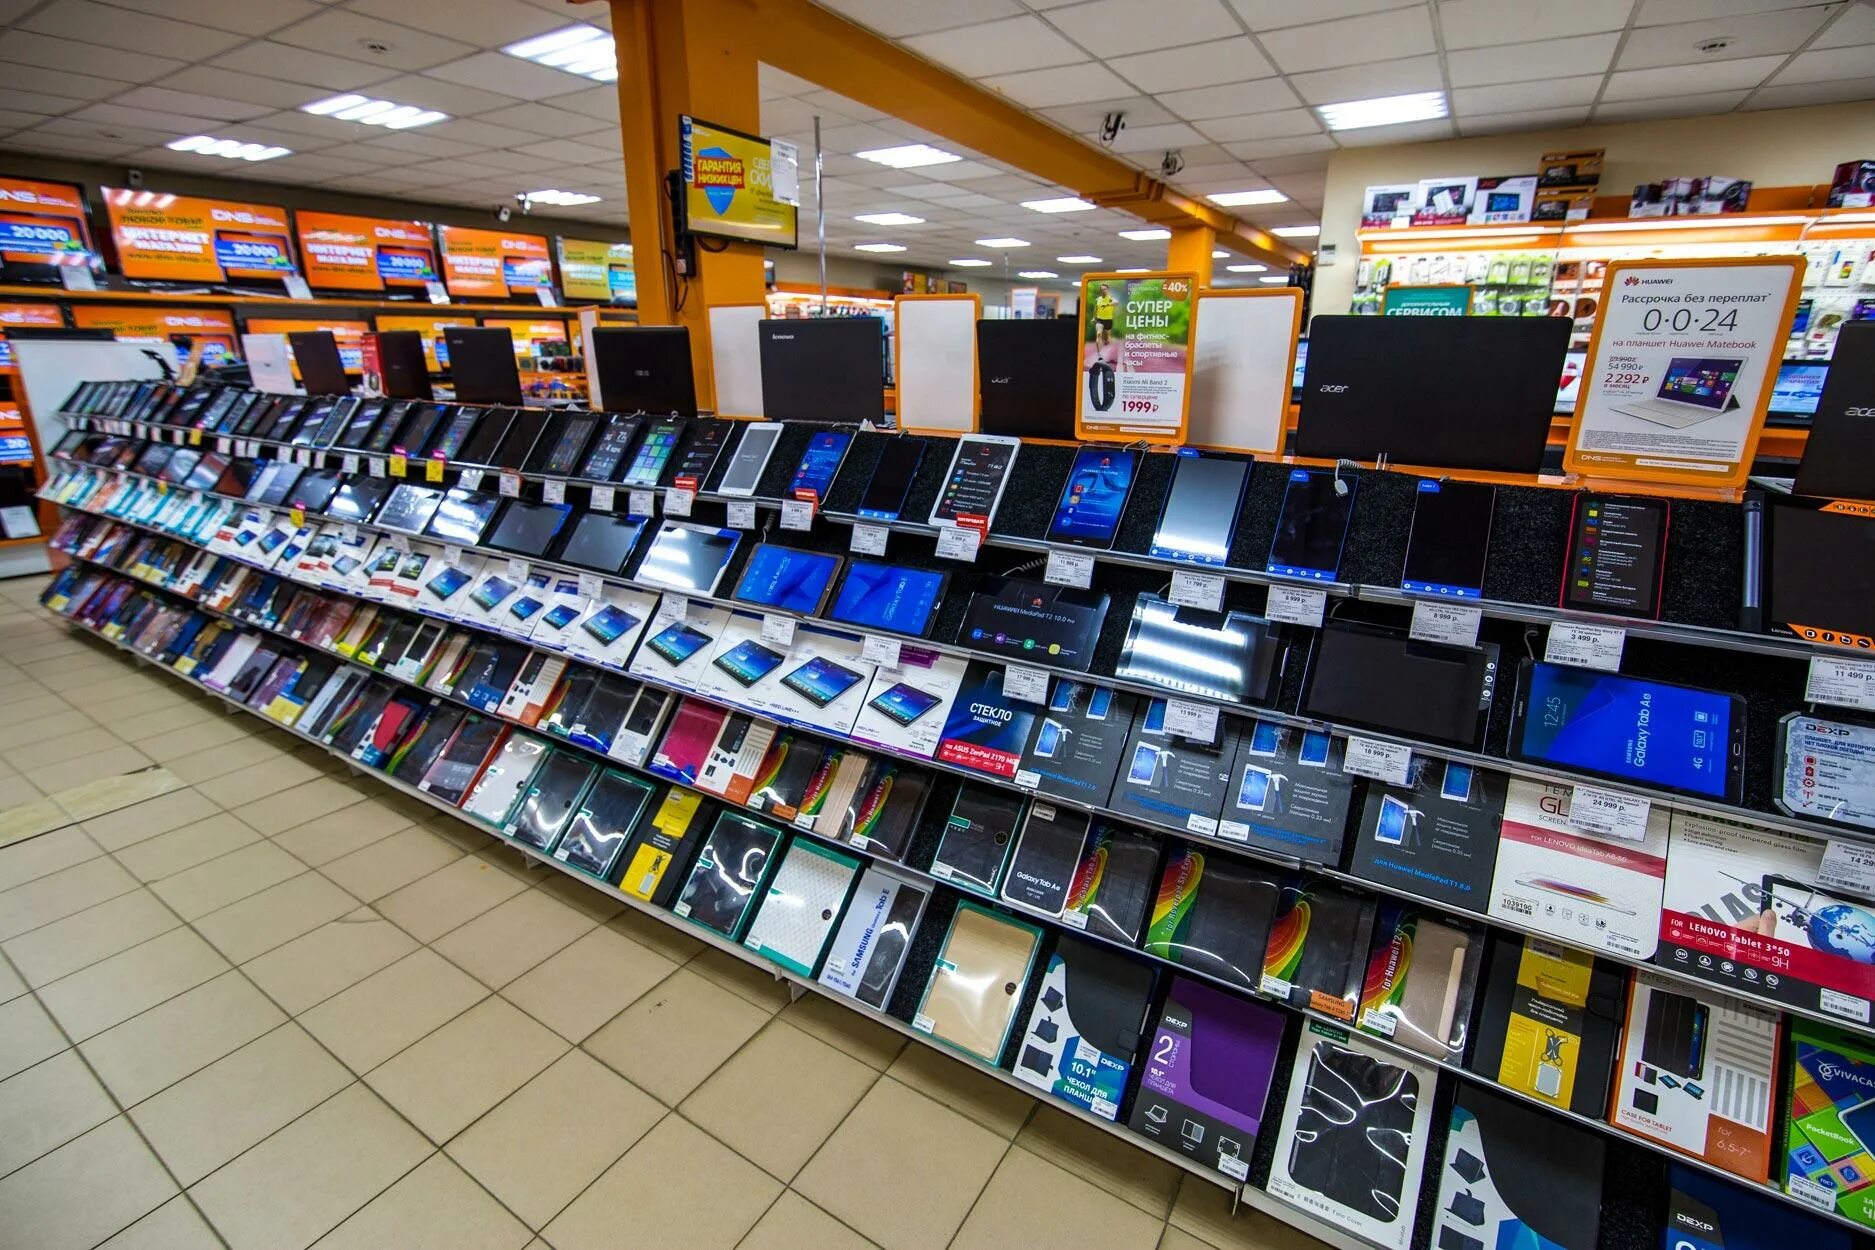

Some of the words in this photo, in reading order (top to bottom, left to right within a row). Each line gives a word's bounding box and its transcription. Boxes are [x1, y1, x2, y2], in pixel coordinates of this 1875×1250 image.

[698, 159, 742, 173] ГАРАНТИЯ
[1621, 294, 1681, 305] Рассрочка
[1684, 293, 1705, 303] без
[1126, 301, 1173, 314] СУПЕР
[1125, 315, 1169, 329] ЦЕНЫ
[1124, 341, 1162, 350] браслеты
[1626, 340, 1667, 349] планшет
[1669, 340, 1704, 348] Huawei
[1707, 340, 1757, 349] Matebook
[1131, 351, 1178, 359] спортивные
[1125, 359, 1143, 367] часы
[1320, 384, 1349, 393] acer
[1845, 407, 1875, 417] ace
[1771, 627, 1793, 636] Lenovo
[1847, 671, 1863, 679] 499
[970, 703, 1012, 721] СТЕКЛО
[1637, 708, 1650, 730] Tab
[973, 716, 1002, 727] ЗАЩИТНОЕ
[1805, 723, 1850, 736] DEXP
[953, 744, 969, 754] ASUS
[970, 748, 990, 759] ZenPad
[990, 752, 1005, 762] Z170
[1633, 731, 1648, 768] Galaxy
[1693, 756, 1704, 769] 4G
[1540, 796, 1569, 817] GL
[1603, 801, 1617, 809] 999
[1538, 815, 1567, 826] SCREEN
[1544, 837, 1576, 850] LENOVO
[1739, 833, 1772, 845] tempered
[1773, 842, 1791, 850] glass
[1851, 856, 1861, 864] 14
[1863, 859, 1875, 868] 29
[1017, 871, 1039, 885] Galaxy
[1039, 879, 1051, 888] Tab
[1389, 862, 1414, 875] Huawei
[1414, 869, 1449, 885] MediaPad
[1503, 898, 1532, 911] 1039190
[852, 927, 874, 968] SAMSUNG
[875, 895, 888, 910] Tab
[1671, 918, 1684, 928] FOR
[1689, 922, 1727, 939] LENOVO
[1730, 933, 1762, 949] Tablet
[1392, 934, 1402, 946] T2
[1385, 946, 1400, 977] Huawei
[1771, 955, 1789, 970] 9H
[1382, 977, 1392, 991] for
[1166, 1016, 1188, 1027] DEXP
[1154, 1035, 1173, 1065] 2
[1071, 1062, 1096, 1078] 10.1"
[1101, 1058, 1125, 1071] DEXP
[1064, 1085, 1094, 1103] ПЛАНШ
[1067, 1076, 1090, 1091] ЧЕХОЛ
[1091, 1087, 1108, 1099] ДЛЯ
[1622, 1109, 1637, 1118] CASE
[1638, 1115, 1651, 1124] FOR
[1652, 1120, 1672, 1132] TABLET
[1806, 1123, 1855, 1146] PocketBook
[1676, 1213, 1714, 1231] DEXP
